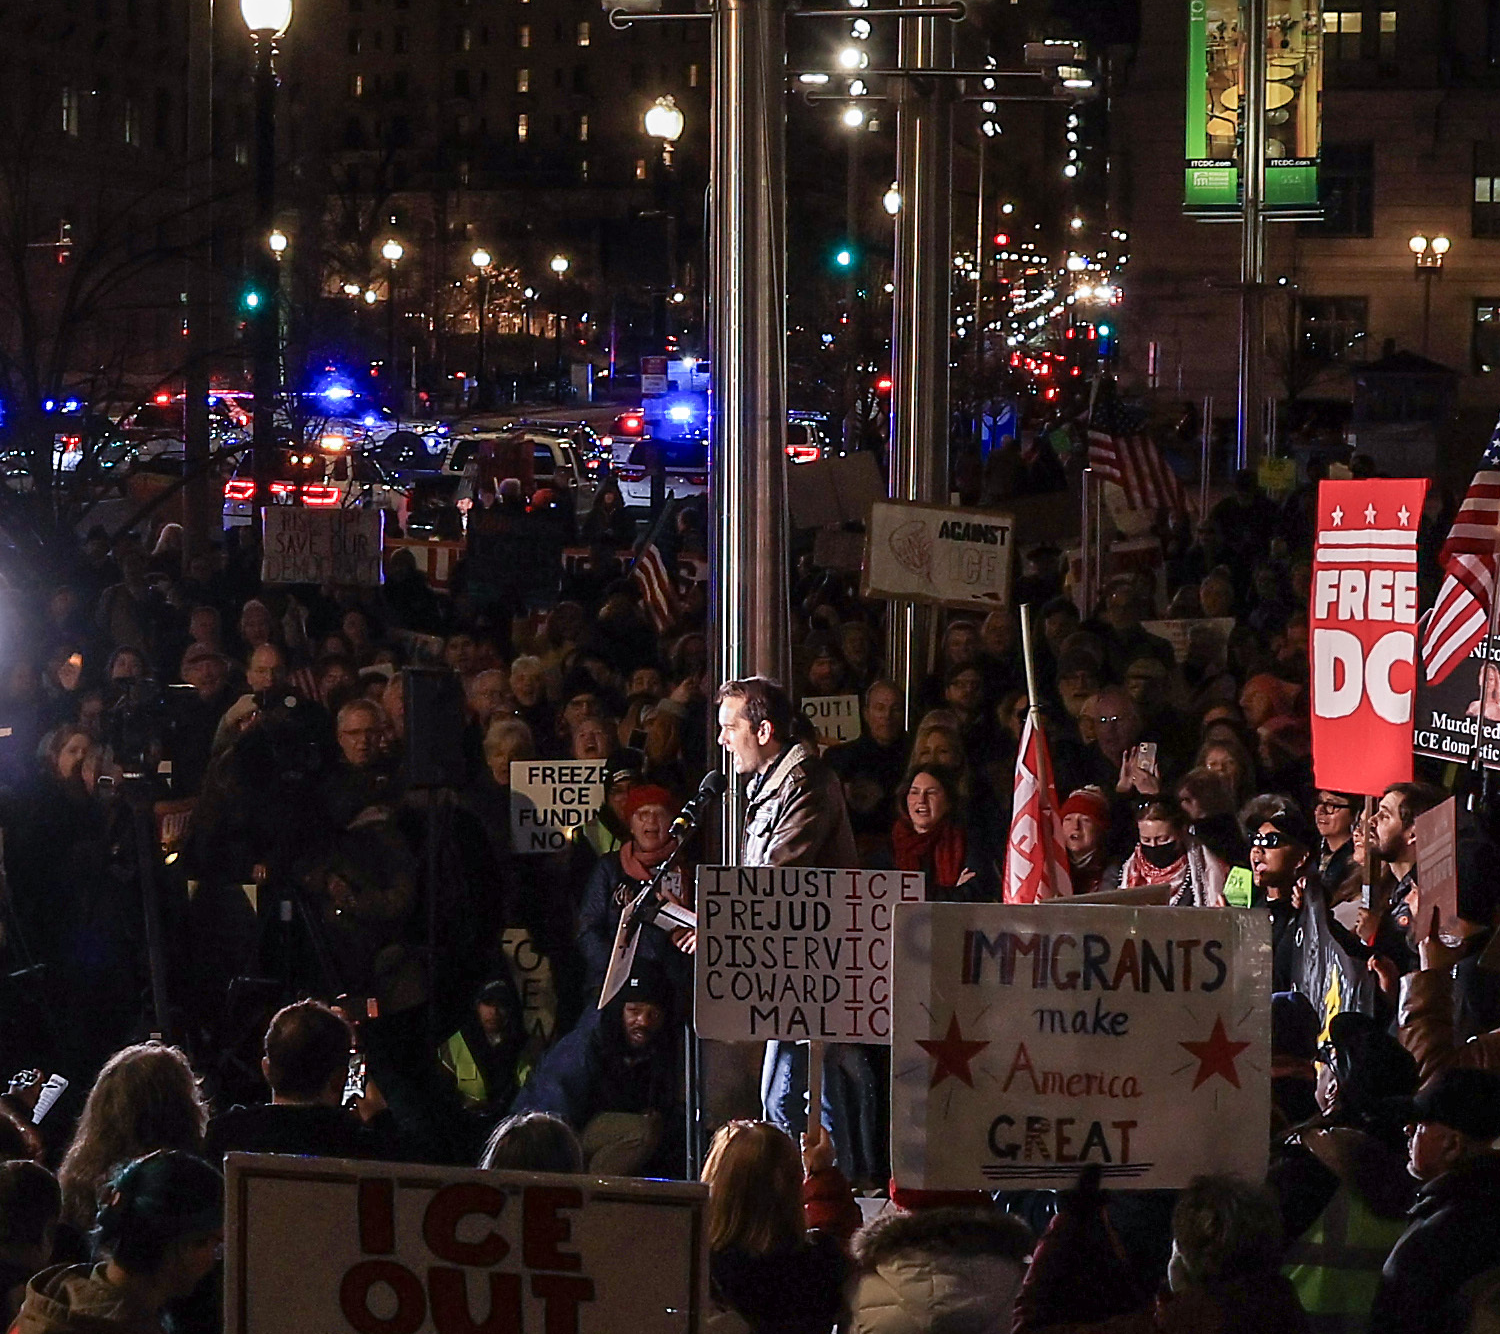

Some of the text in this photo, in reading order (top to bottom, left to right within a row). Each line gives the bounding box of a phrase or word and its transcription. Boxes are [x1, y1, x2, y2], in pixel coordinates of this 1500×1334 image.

[1191, 159, 1232, 168] ITCDC.com
[275, 532, 321, 555] SAVE
[939, 520, 1010, 546] AGAINST
[949, 548, 998, 585] ICE
[1315, 568, 1418, 625] FREE
[1314, 627, 1416, 725] DC
[802, 702, 853, 719] OUT!
[1414, 730, 1439, 750] ICE
[552, 787, 591, 806] ICE
[519, 808, 600, 827] FUNDIN
[530, 831, 576, 850] NO
[706, 867, 920, 902] INJUSTICE
[706, 899, 891, 932] PREJUDIC
[706, 934, 890, 971] DISSERVIC
[961, 930, 1228, 993] IMMIGRANTS
[706, 970, 889, 1004] COWARDIC
[750, 1005, 890, 1037] MALIC
[1032, 997, 1130, 1036] make
[1002, 1041, 1144, 1100] America
[987, 1113, 1139, 1164] GREAT
[356, 1176, 585, 1271] ICE
